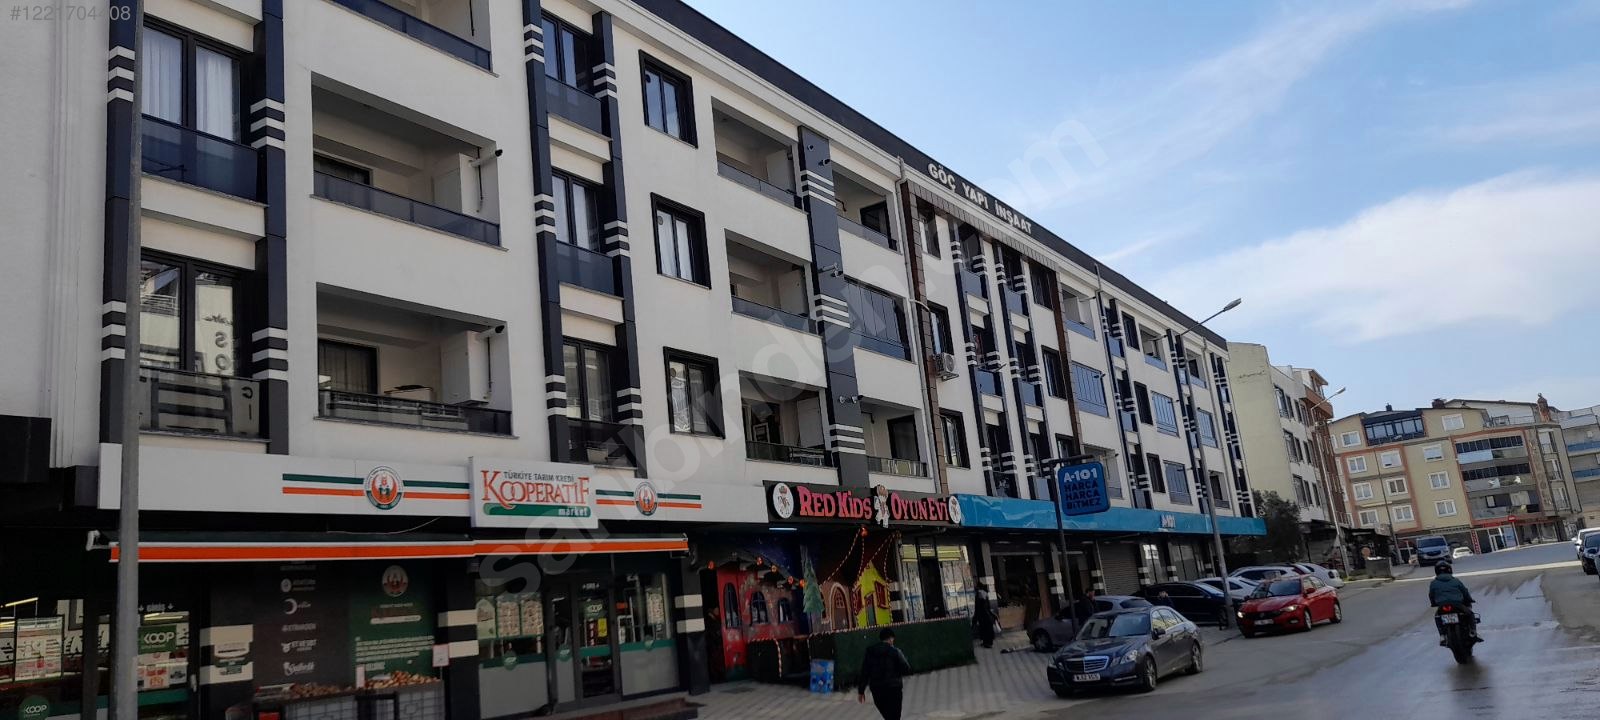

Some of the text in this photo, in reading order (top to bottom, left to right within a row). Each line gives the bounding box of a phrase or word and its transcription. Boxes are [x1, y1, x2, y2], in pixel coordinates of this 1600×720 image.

[927, 163, 1032, 235] GÖÇ YAPI İNŞAAT
[504, 469, 574, 483] TÜRKİYE TARIM KREDİ
[1063, 467, 1098, 484] A-101
[481, 471, 590, 509] KOOPERATİF
[1064, 480, 1099, 493] HARCA
[797, 485, 835, 517] RED
[890, 492, 928, 520] OYUN
[1065, 489, 1100, 502] HARCA
[558, 506, 588, 517] market
[143, 631, 175, 645] KOOP
